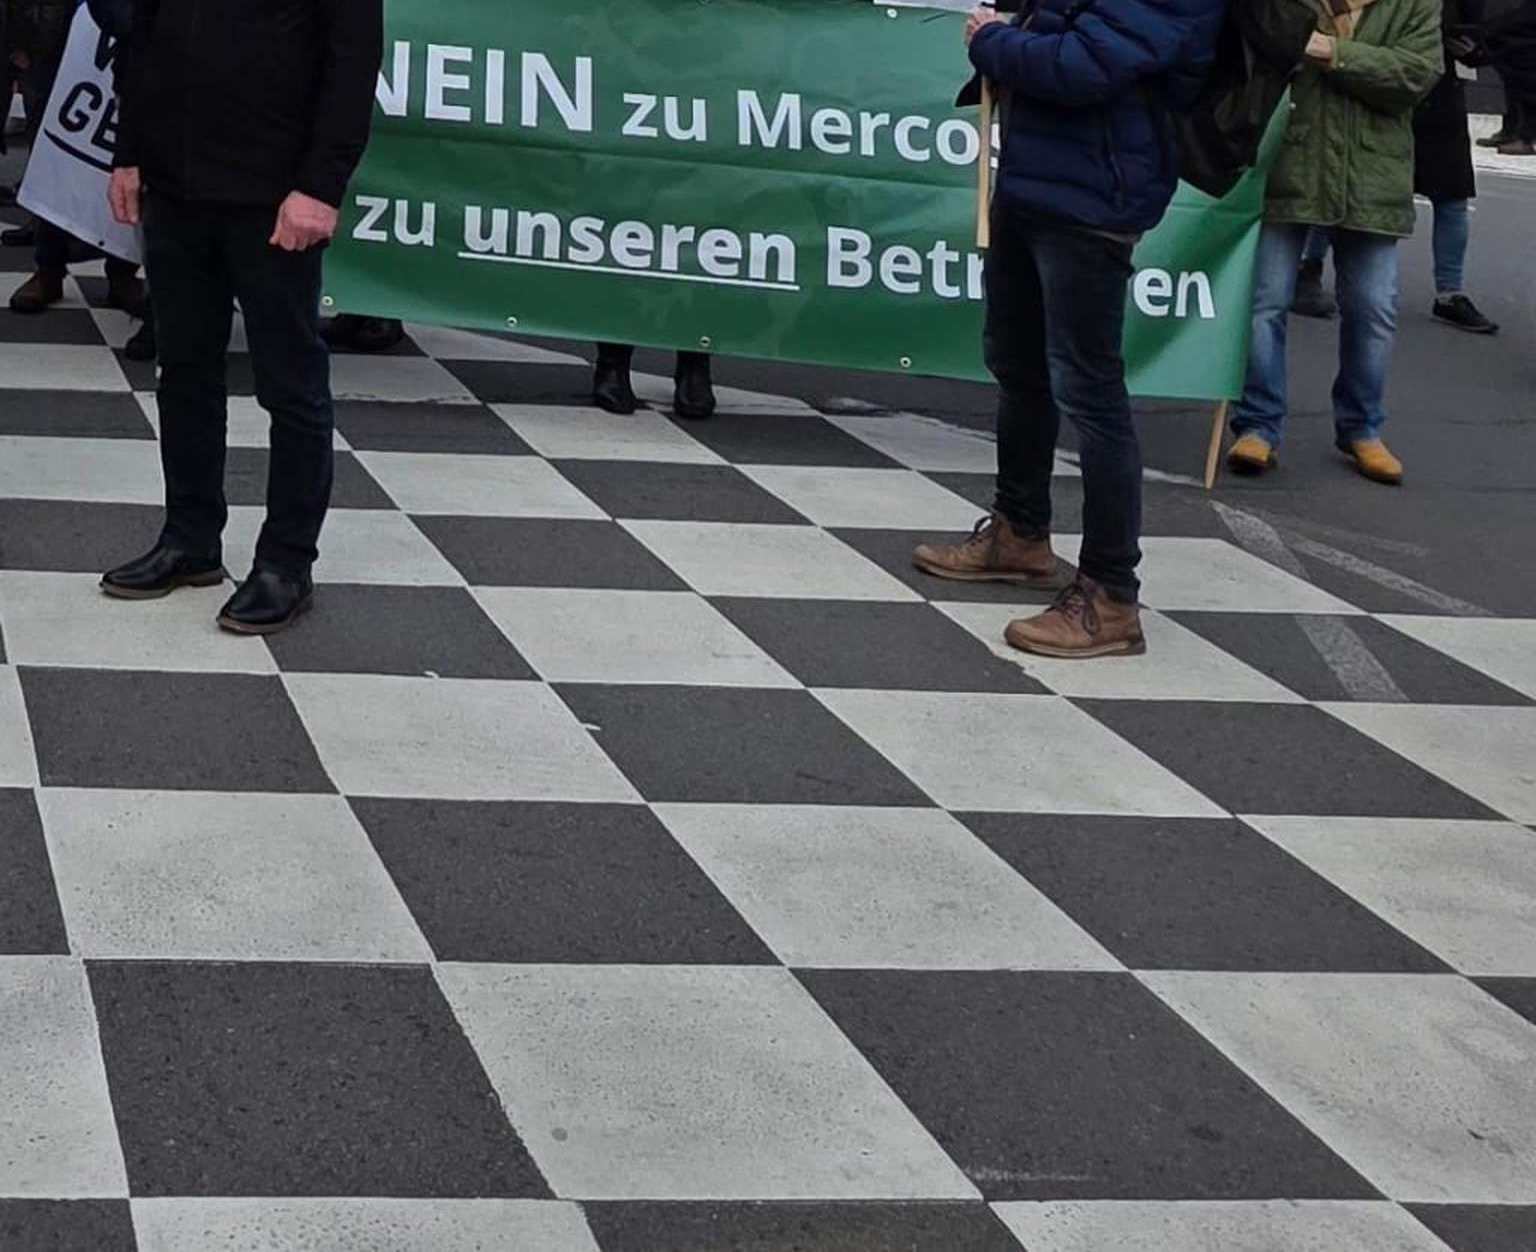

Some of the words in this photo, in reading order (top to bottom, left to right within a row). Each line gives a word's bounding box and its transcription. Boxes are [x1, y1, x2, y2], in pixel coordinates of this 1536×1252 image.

[622, 92, 707, 141] zu
[352, 195, 436, 247] zu
[464, 205, 798, 289] unseren
